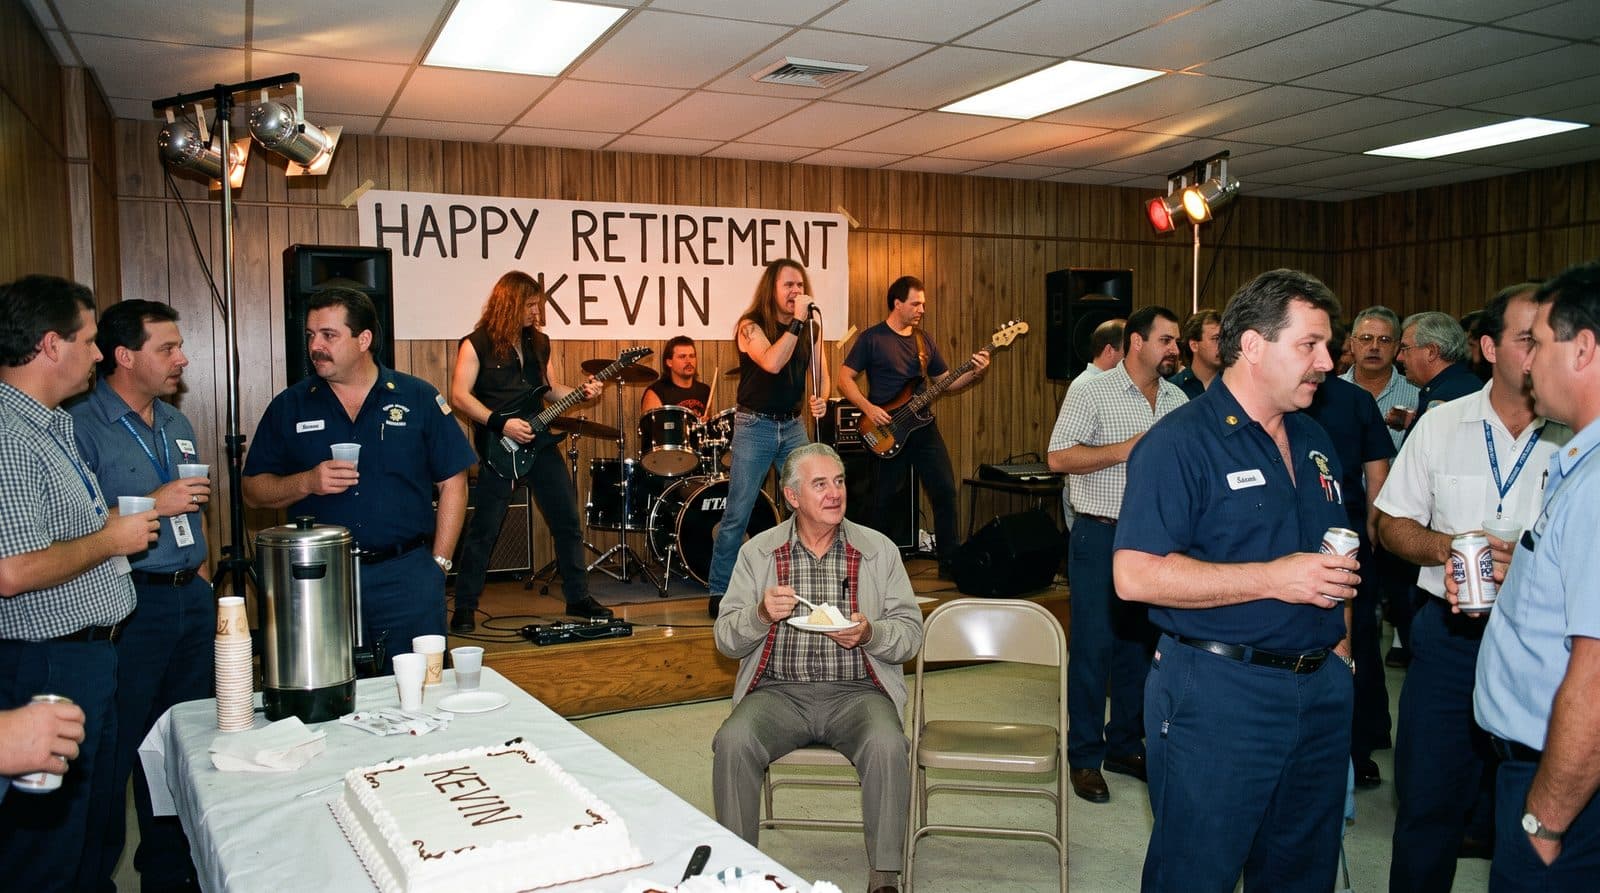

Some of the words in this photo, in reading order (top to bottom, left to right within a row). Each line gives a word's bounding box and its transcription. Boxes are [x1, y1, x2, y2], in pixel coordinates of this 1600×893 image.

[375, 202, 539, 260] HAPPY
[572, 209, 838, 270] RETIREMENT
[537, 272, 710, 327] KEVIN
[424, 766, 522, 826] KEVIN
